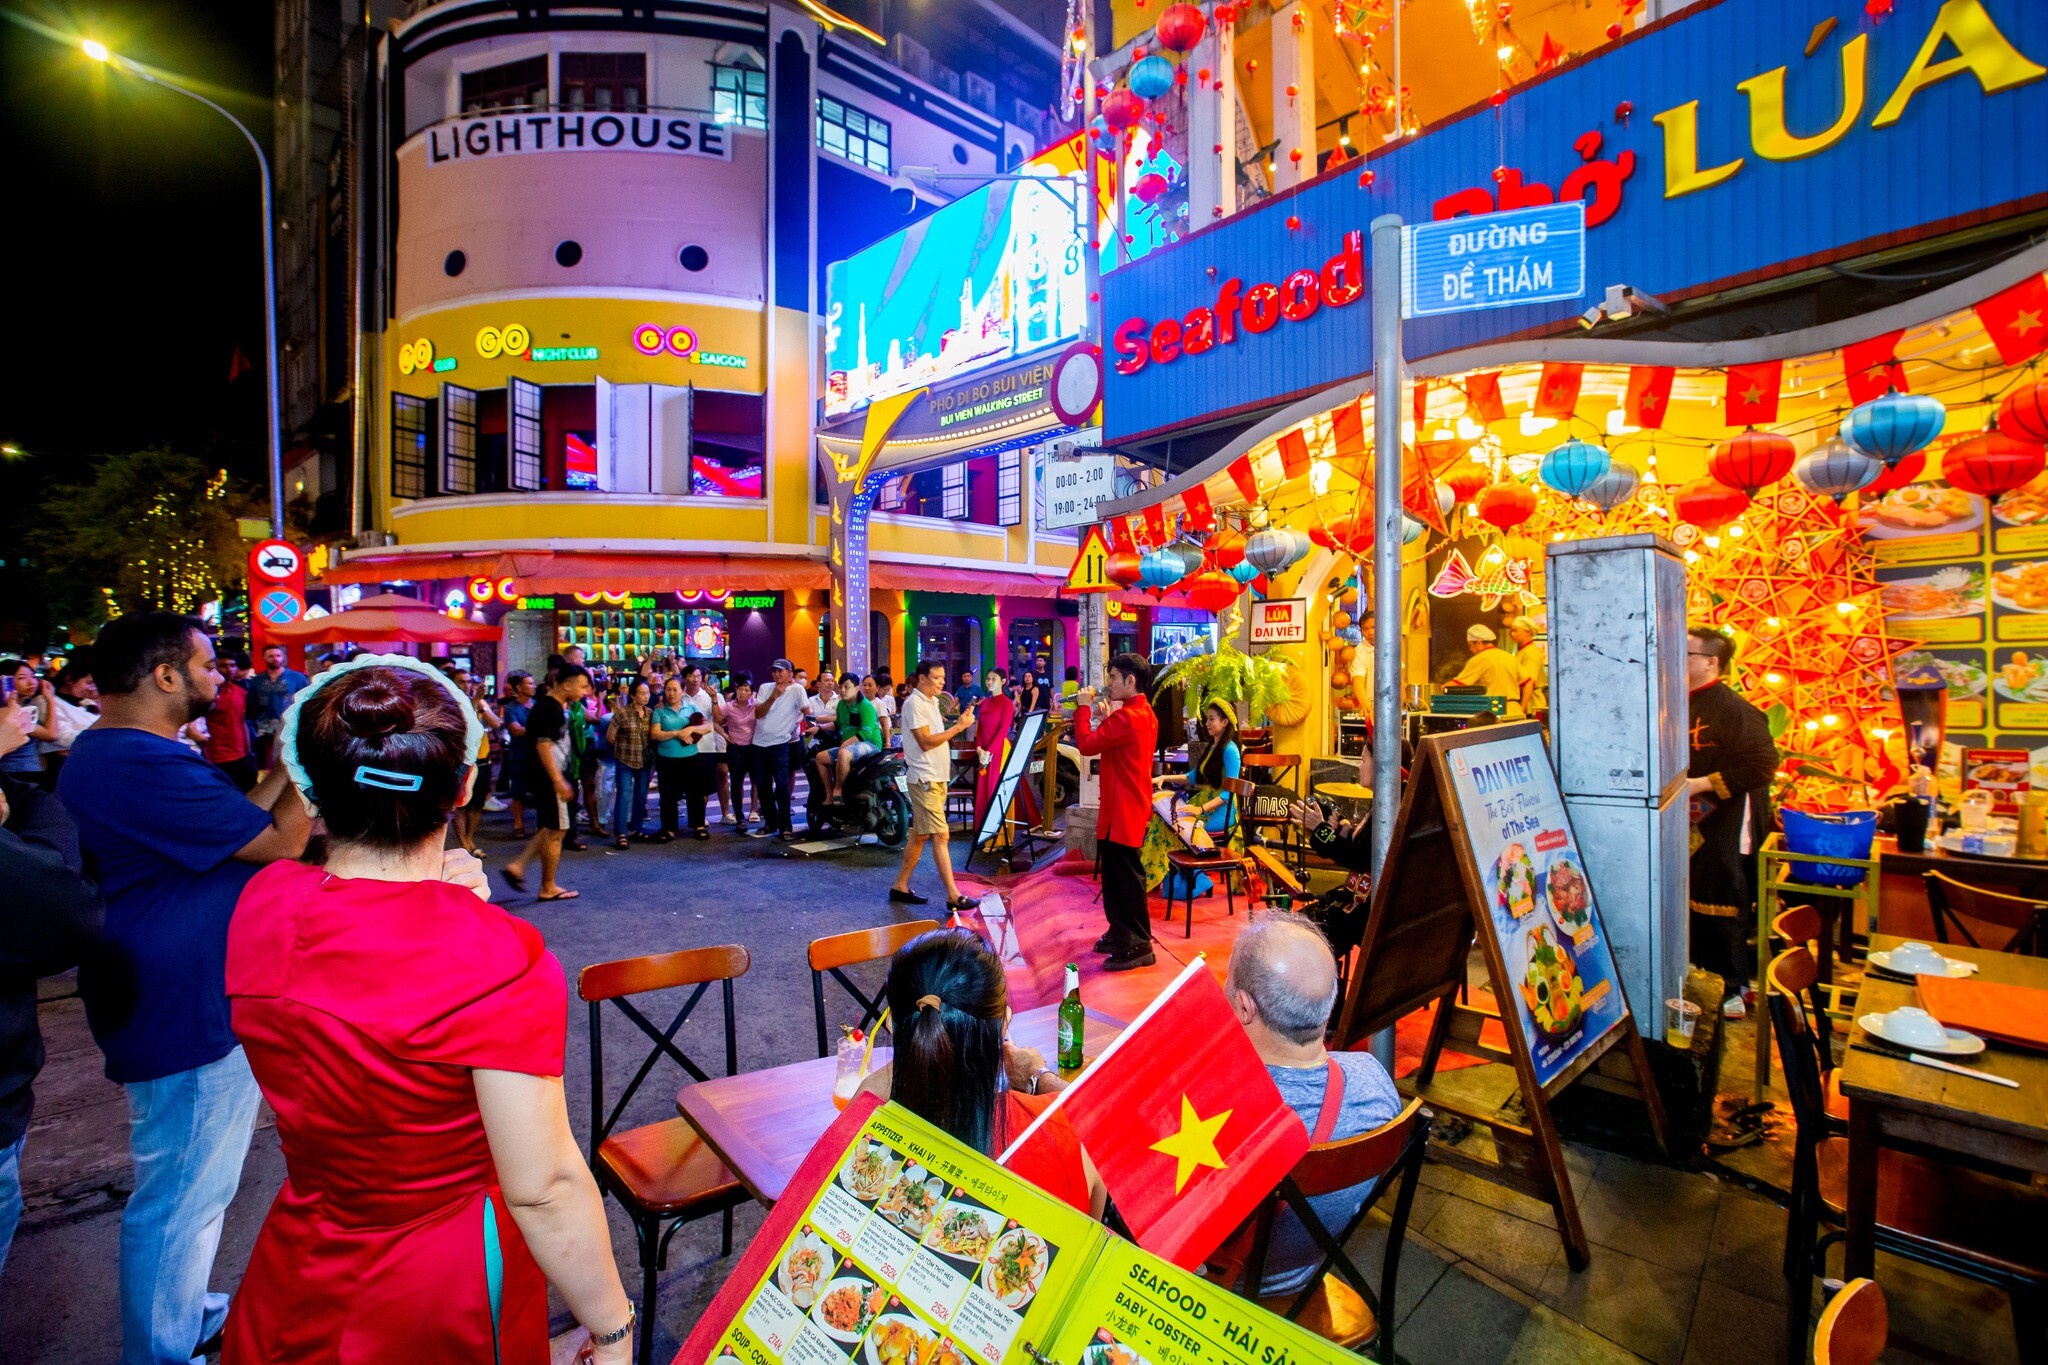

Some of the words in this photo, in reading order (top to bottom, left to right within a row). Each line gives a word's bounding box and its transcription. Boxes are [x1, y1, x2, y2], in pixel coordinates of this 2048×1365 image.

[1653, 0, 2047, 199] LÚA
[431, 115, 724, 163] LIGHTHOUSE
[1448, 222, 1548, 256] ĐƯỜNG
[1443, 261, 1475, 301] ĐỀ
[1483, 256, 1553, 296] THÁM
[1113, 230, 1363, 375] Seafood
[700, 352, 747, 368] SAIGON
[972, 382, 990, 400] BỘ
[993, 376, 1017, 395] BÙI
[1020, 364, 1055, 388] VIỆN
[941, 413, 954, 426] BUI
[955, 408, 973, 423] VIEN
[974, 397, 1012, 419] WALKING
[1013, 387, 1044, 407] STREET
[1055, 475, 1077, 488] 00:00
[1086, 467, 1103, 482] 2:00
[1054, 501, 1075, 516] 19:00
[526, 598, 555, 609] WINE
[632, 598, 655, 609] BAR
[735, 597, 775, 609] EATERY
[1266, 606, 1289, 622] LÚA
[1502, 822, 1511, 839] of
[1509, 820, 1525, 836] The
[1524, 815, 1540, 830] Sea
[871, 1121, 903, 1144] APPETIZER
[907, 1142, 927, 1157] KHAI
[926, 1153, 936, 1165] VỊ
[970, 1178, 1009, 1204] 에피타이저
[836, 1228, 853, 1244] 252k
[879, 1262, 899, 1280] 252k
[943, 1270, 954, 1281] HEO
[930, 1301, 951, 1321] 252k
[991, 1307, 1004, 1318] TÔM
[1129, 1263, 1207, 1320] SEAFOOD
[1223, 1321, 1259, 1355] HẢI
[1105, 1309, 1140, 1338] 小龙虾
[1115, 1292, 1148, 1318] BABY
[1148, 1313, 1201, 1356] LOBSTER
[732, 1328, 750, 1349] SOUP
[767, 1332, 784, 1351] 274k
[981, 1342, 1003, 1363] 252k
